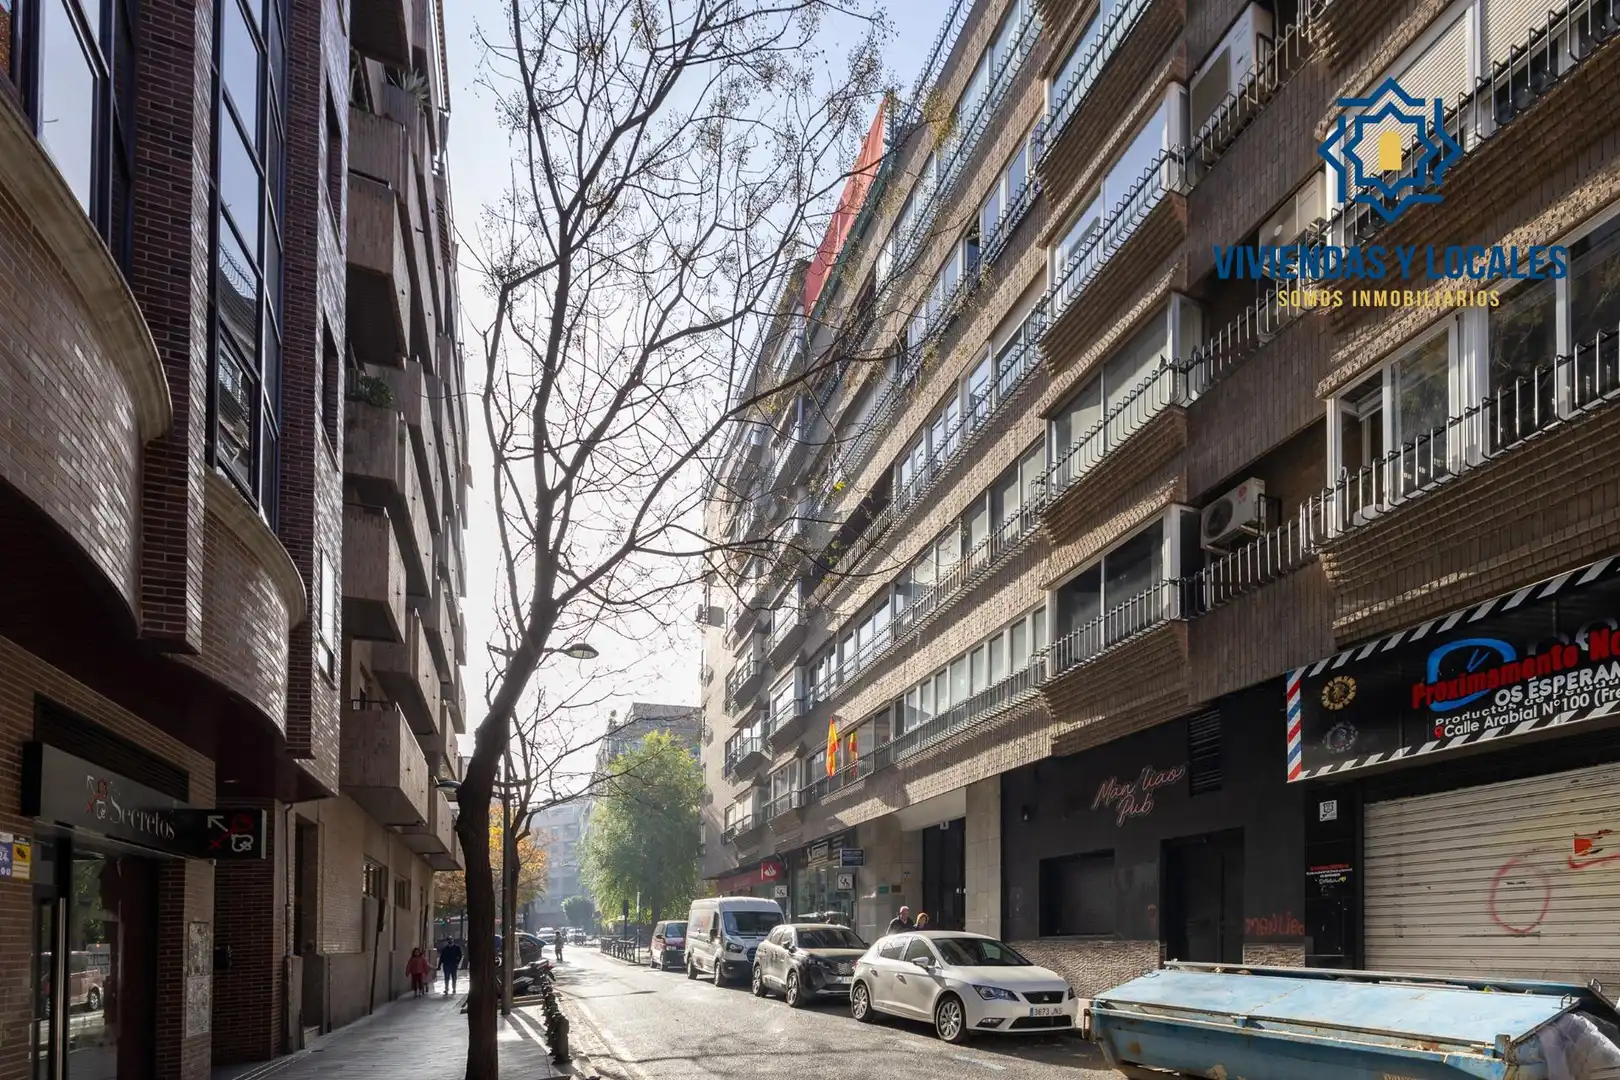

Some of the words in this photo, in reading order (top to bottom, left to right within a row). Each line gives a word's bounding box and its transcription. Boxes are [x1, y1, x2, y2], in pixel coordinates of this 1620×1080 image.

[1495, 684, 1523, 707] OS
[1444, 720, 1480, 738] Calle
[1483, 705, 1538, 729] Arabial
[109, 795, 175, 840] Secretos
[1116, 793, 1155, 827] Pub
